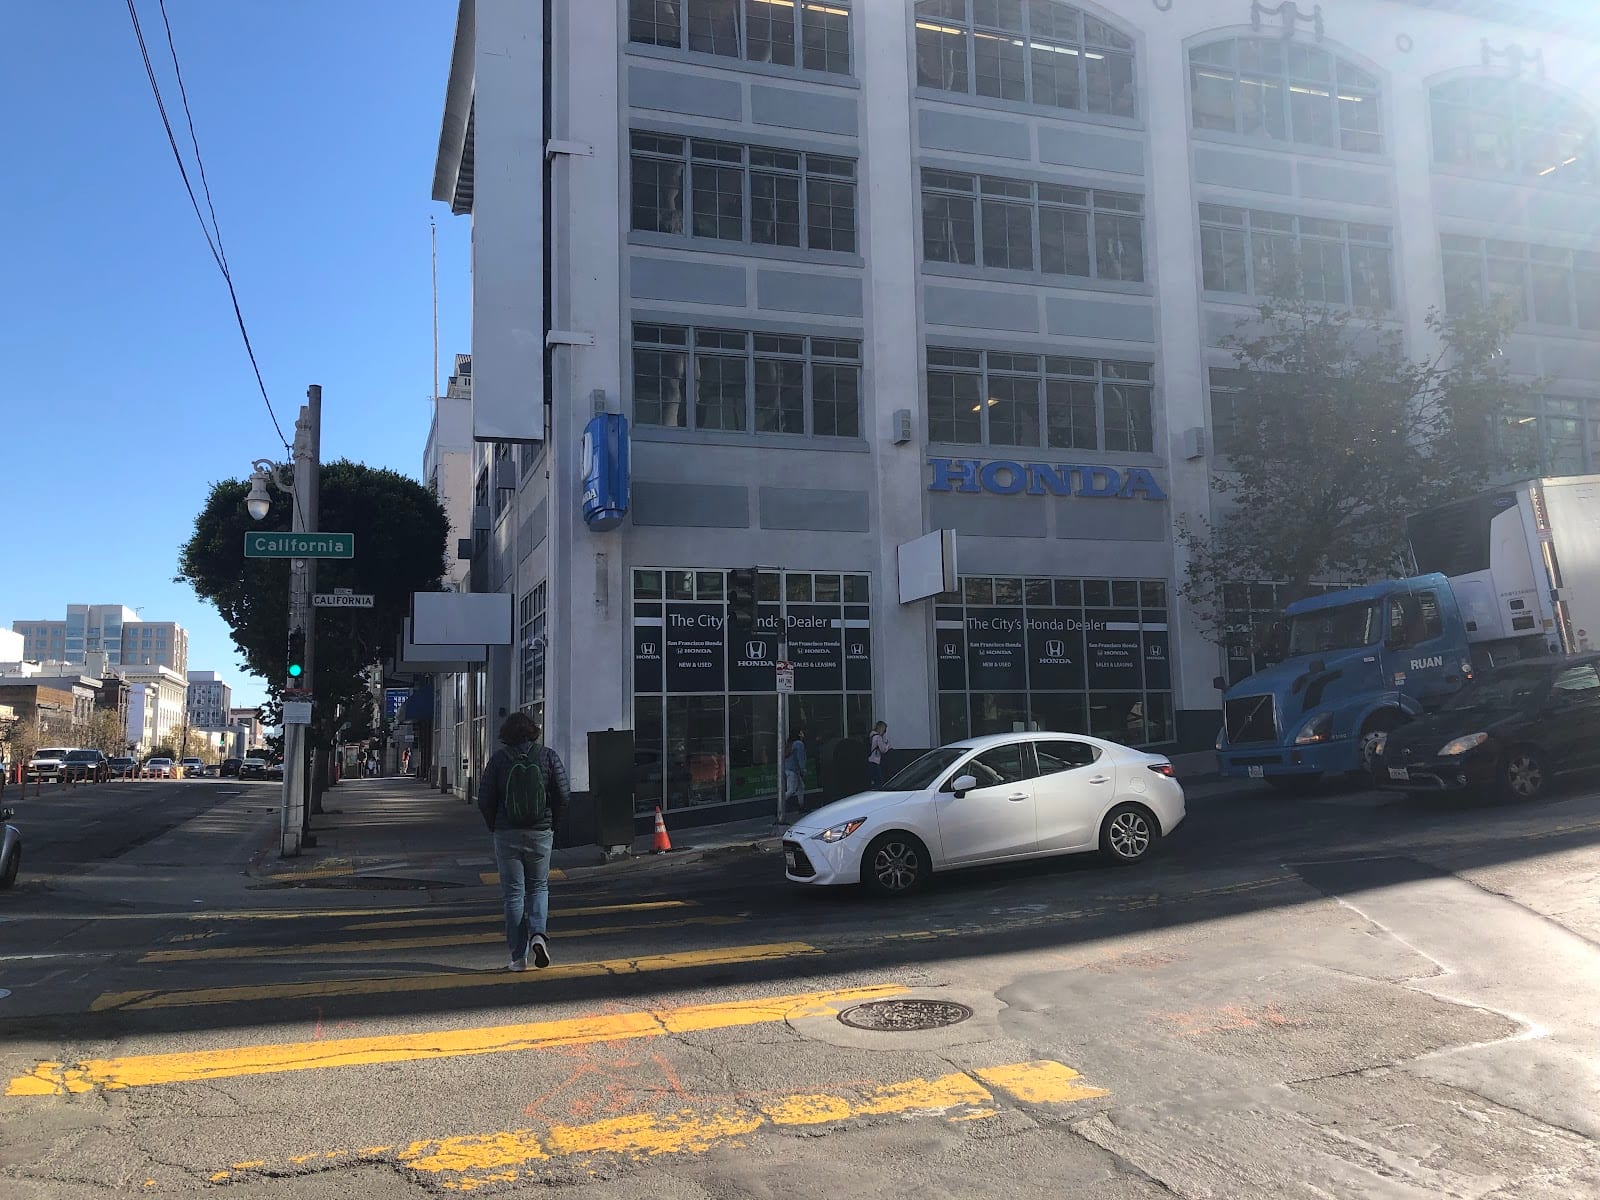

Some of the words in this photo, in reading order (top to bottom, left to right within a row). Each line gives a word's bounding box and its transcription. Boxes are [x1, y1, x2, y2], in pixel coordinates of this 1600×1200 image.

[927, 458, 1168, 500] HONDA
[255, 537, 344, 553] California
[313, 596, 372, 605] CALIFORNIA
[669, 613, 695, 627] The
[697, 613, 731, 630] City'
[757, 614, 779, 628] nda
[787, 615, 828, 628] Dealer
[966, 617, 989, 630] The
[991, 618, 1022, 632] City's
[1025, 618, 1064, 631] Honda
[1066, 619, 1105, 631] Dealer
[1410, 656, 1443, 670] RUAN
